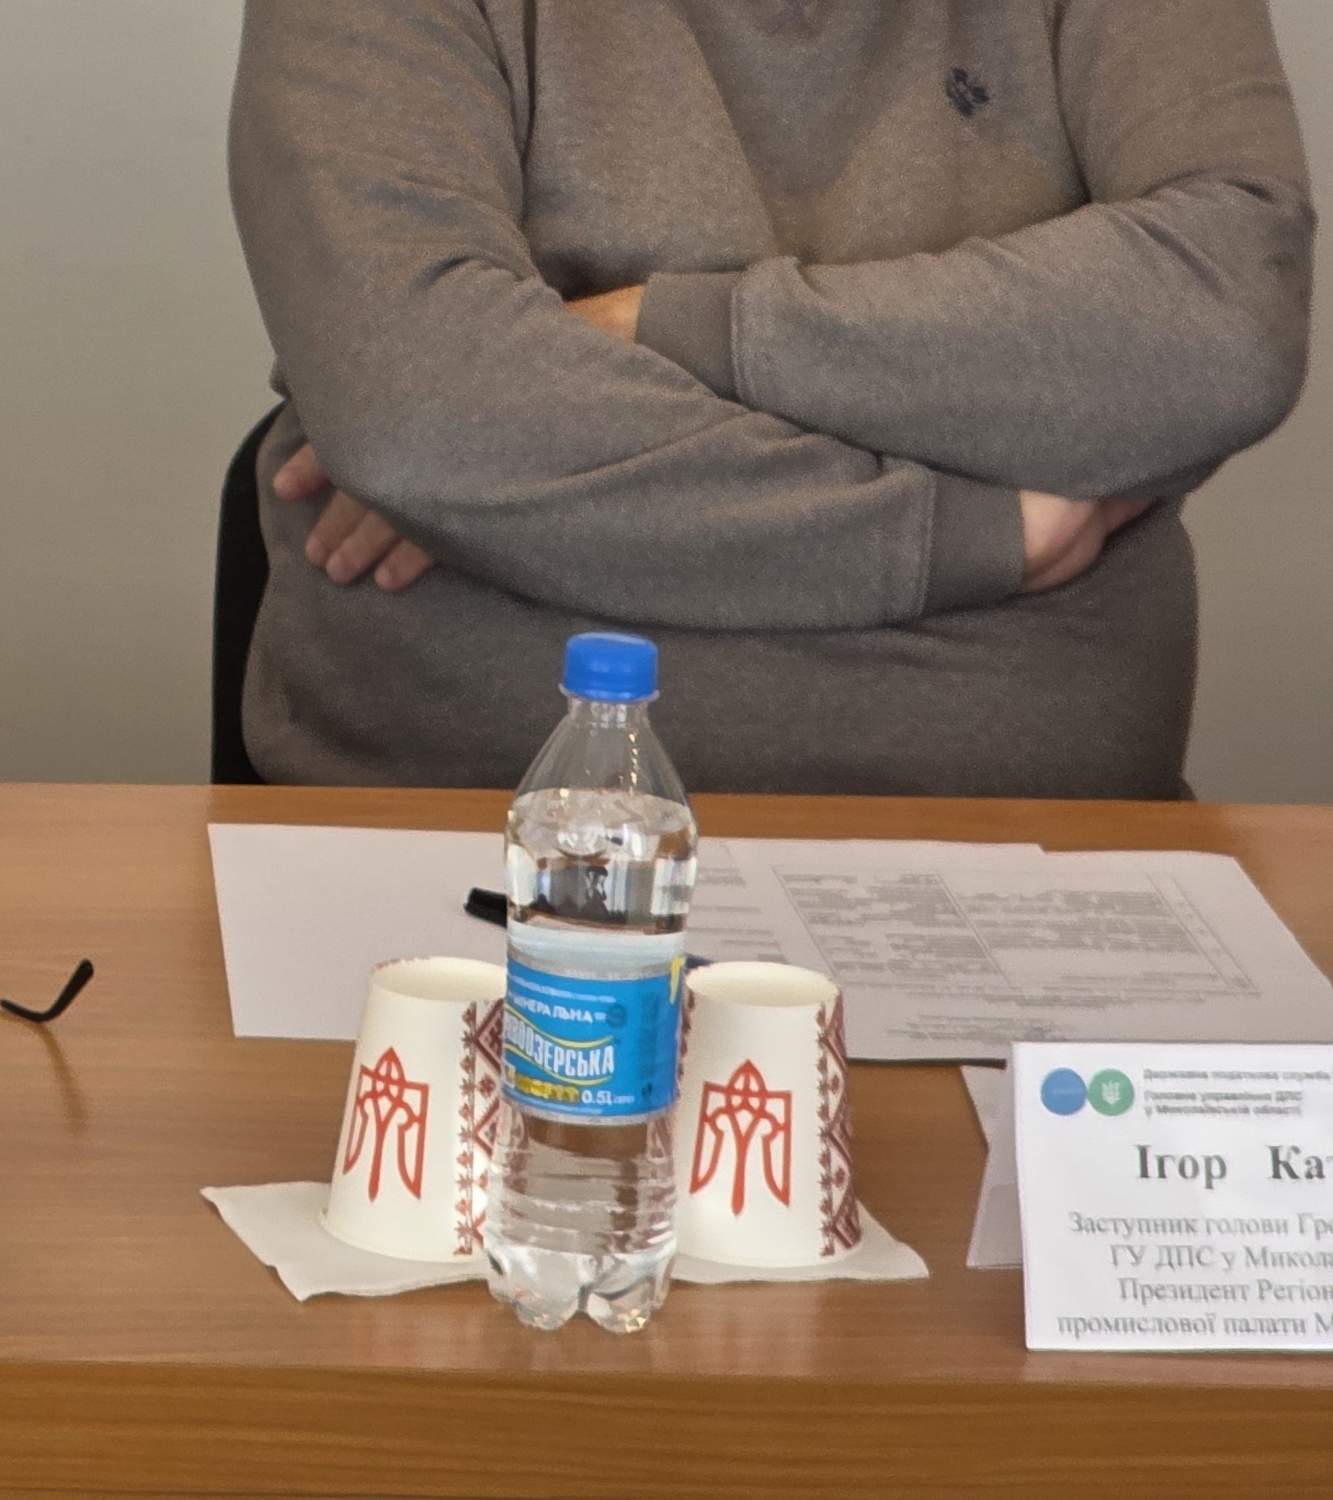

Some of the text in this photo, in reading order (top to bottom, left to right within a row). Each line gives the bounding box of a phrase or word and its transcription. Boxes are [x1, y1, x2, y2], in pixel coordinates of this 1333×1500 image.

[1136, 1144, 1333, 1190] Ігор Ка
[1069, 1211, 1196, 1238] Заступник
[1204, 1218, 1289, 1236] голови
[1111, 1245, 1149, 1267] ГУ
[1155, 1245, 1216, 1269] ДПС
[1222, 1253, 1235, 1271] у
[1117, 1278, 1249, 1305] Президент
[1057, 1316, 1217, 1337] промислової
[1224, 1317, 1305, 1334] палати
